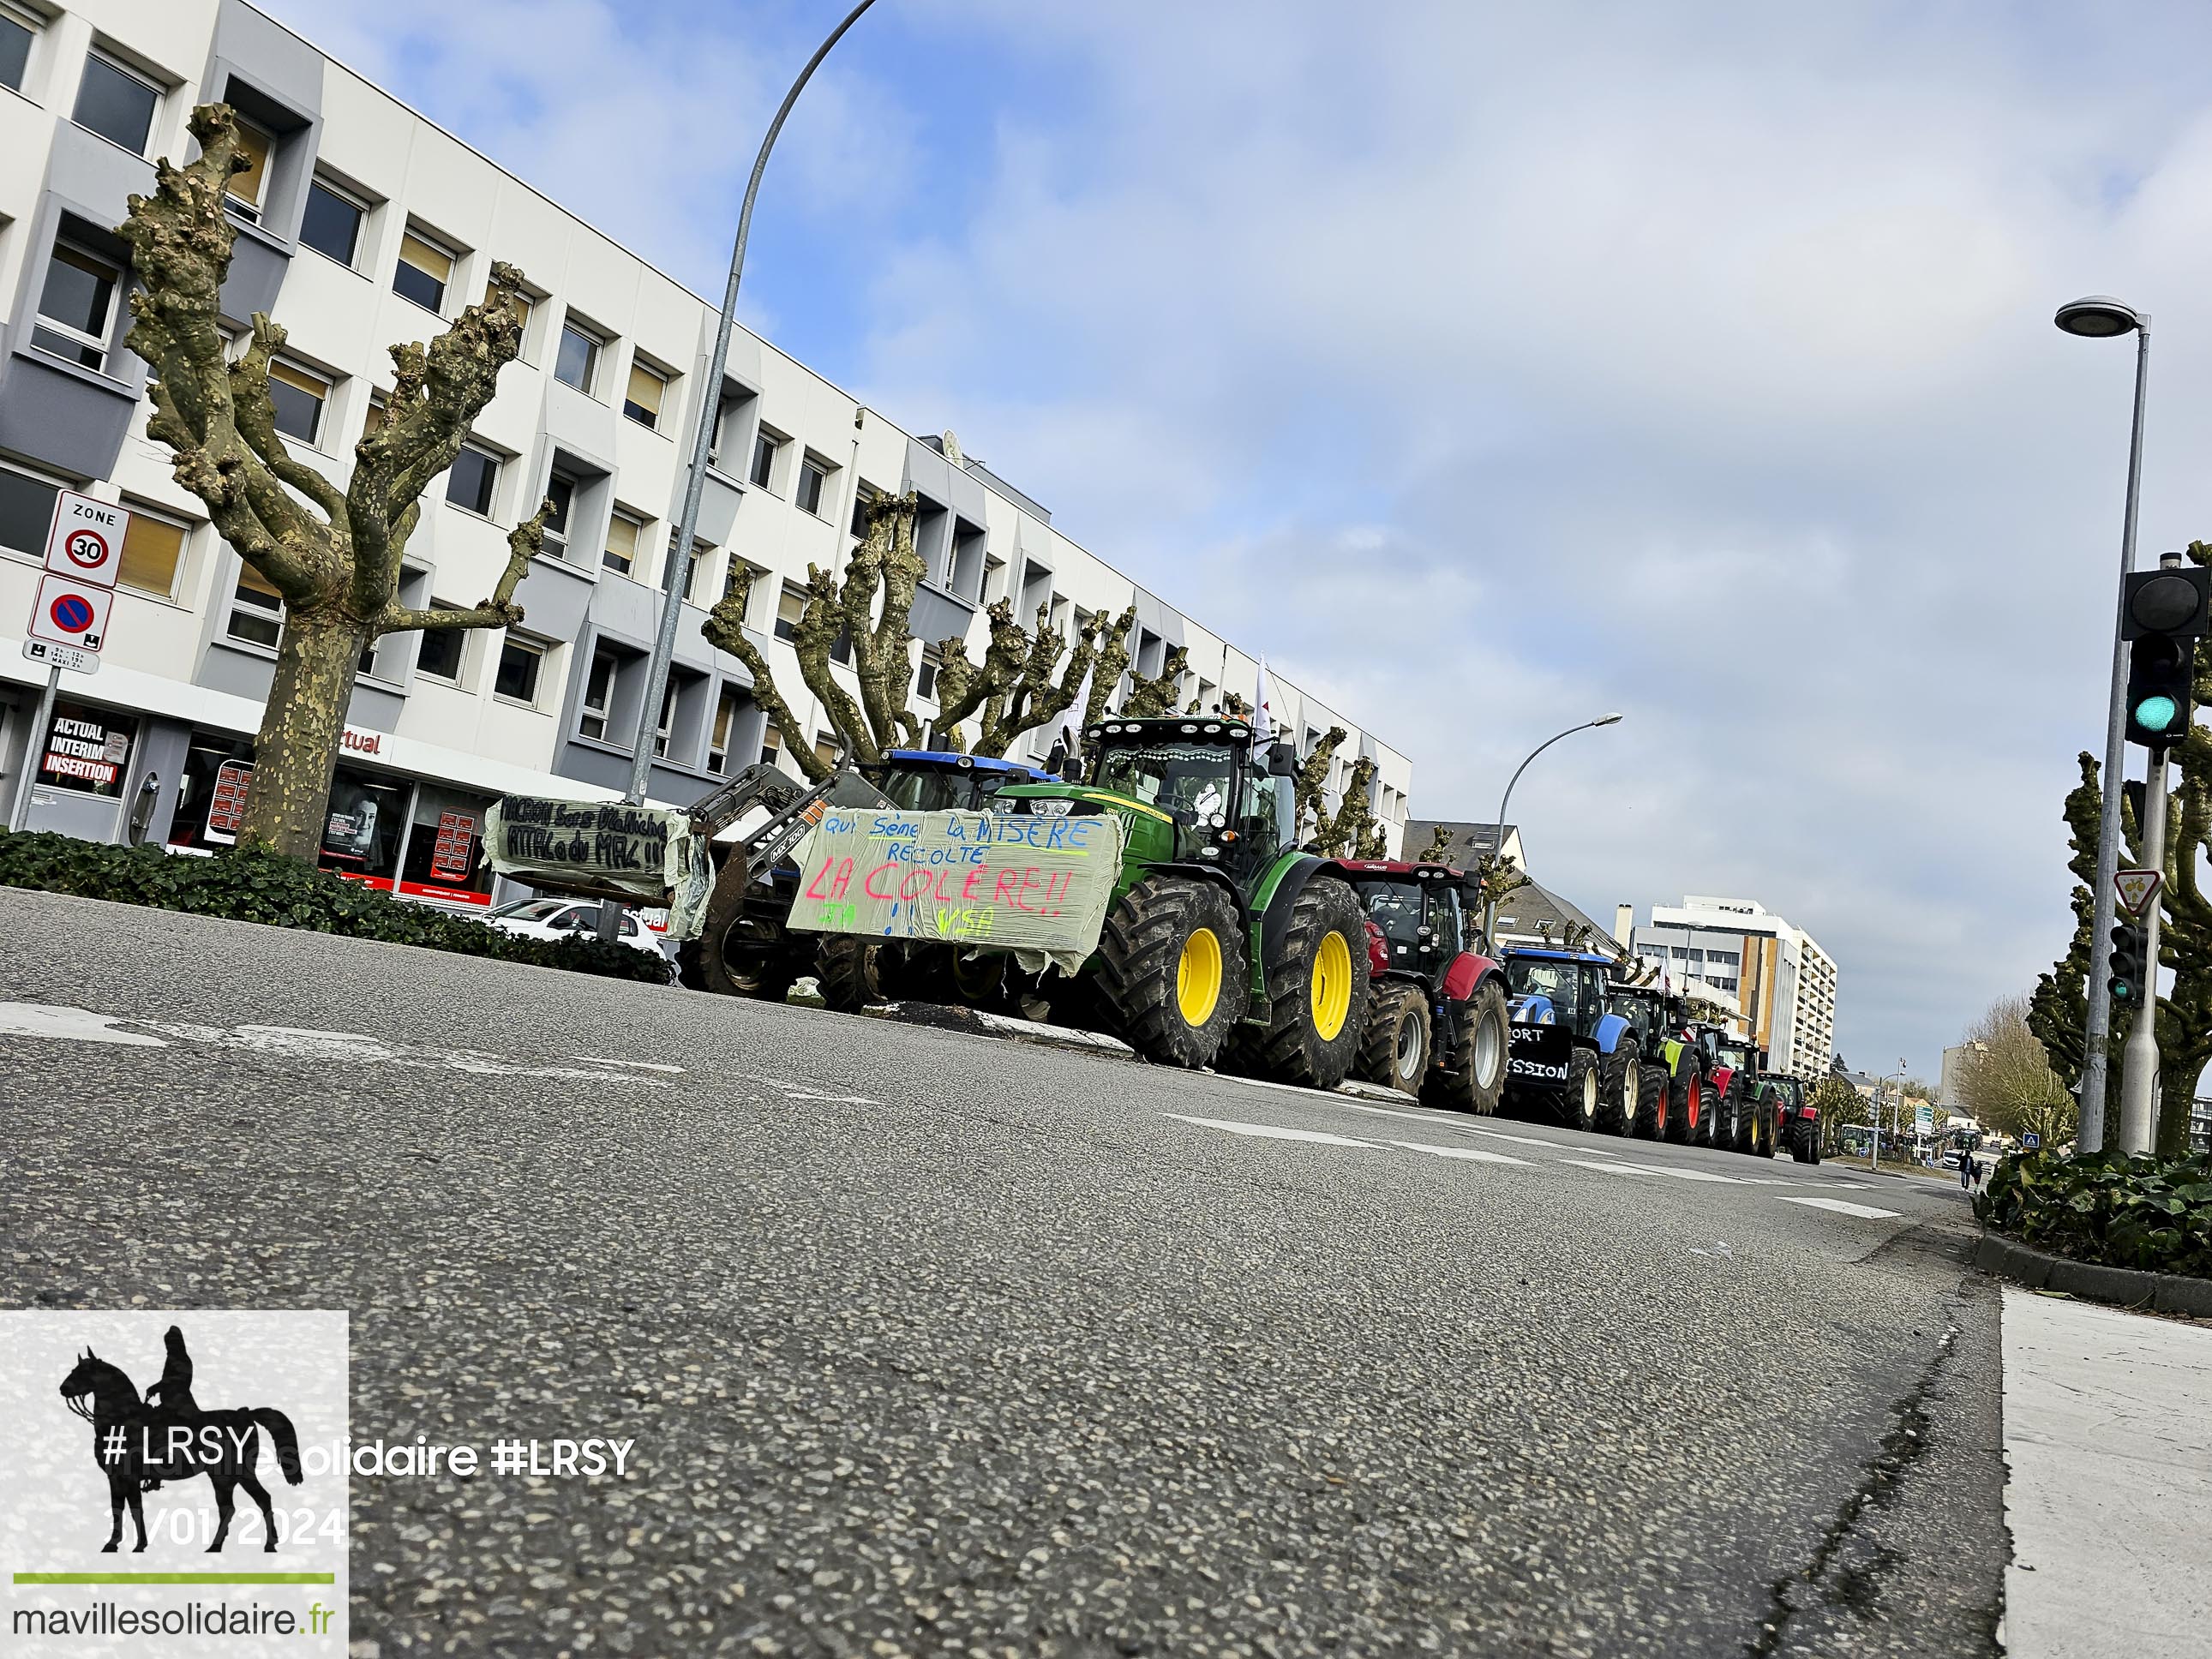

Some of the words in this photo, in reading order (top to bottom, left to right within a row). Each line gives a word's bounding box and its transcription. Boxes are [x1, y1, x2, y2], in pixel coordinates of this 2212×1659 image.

[73, 504, 116, 526] ZONE
[73, 538, 101, 560] 30
[52, 656, 69, 666] MAXI
[54, 717, 104, 741] ACTUAL
[51, 736, 105, 760] INTERIM
[343, 730, 381, 754] tual
[45, 755, 114, 782] INSERTION
[501, 795, 553, 825] MACRON
[507, 826, 554, 860] ATTAL
[568, 830, 590, 862] du
[595, 832, 641, 869] MAL
[806, 857, 853, 901] LA
